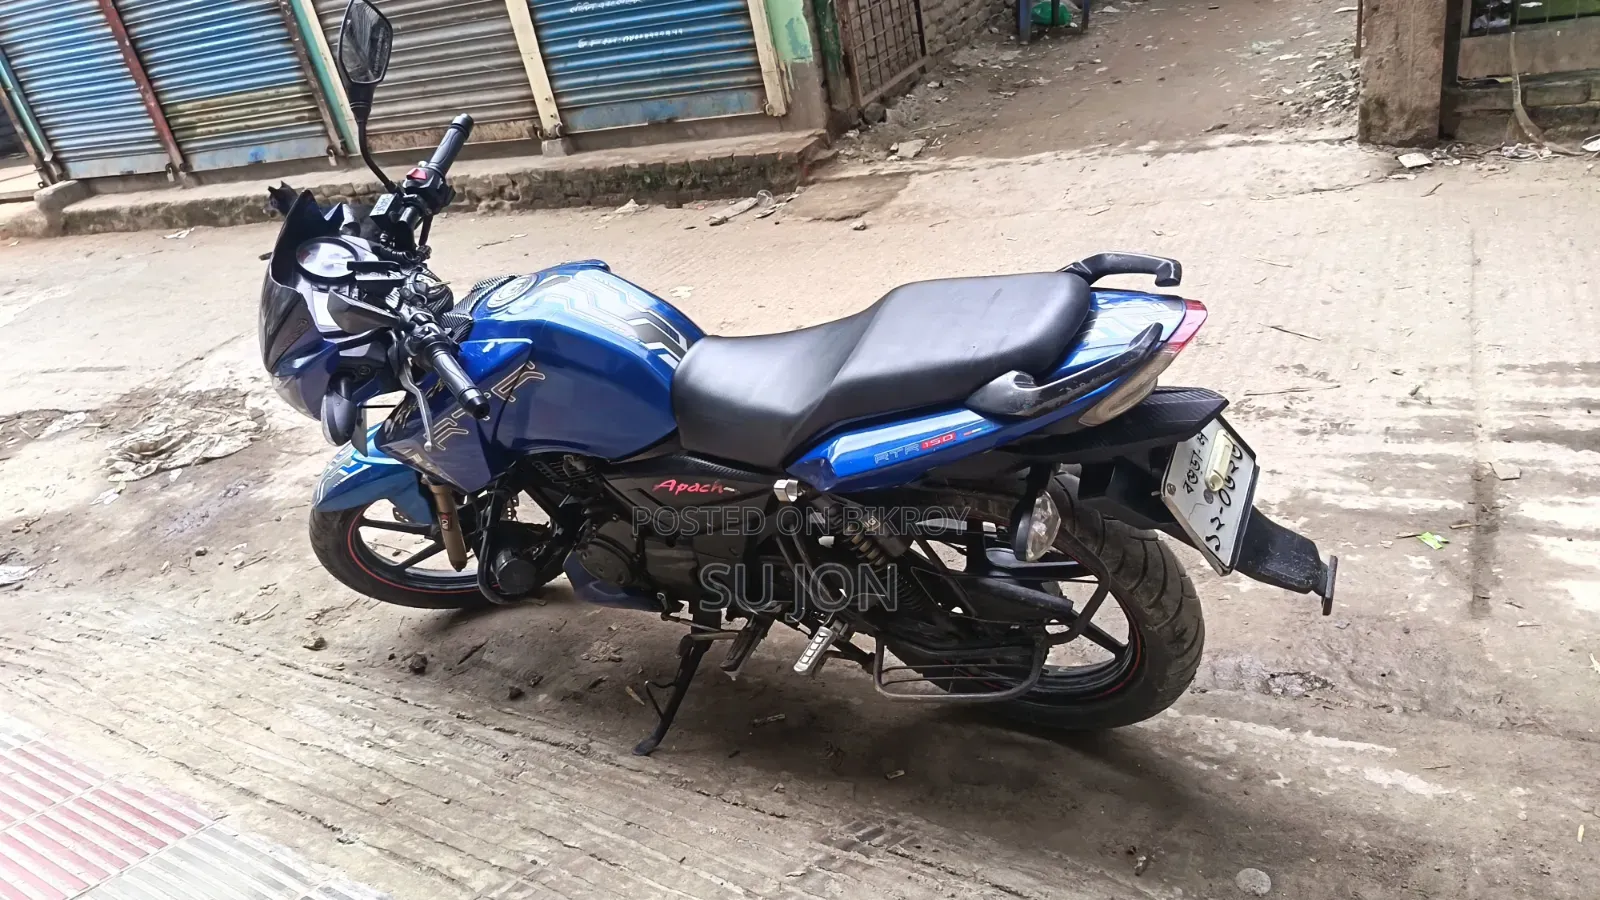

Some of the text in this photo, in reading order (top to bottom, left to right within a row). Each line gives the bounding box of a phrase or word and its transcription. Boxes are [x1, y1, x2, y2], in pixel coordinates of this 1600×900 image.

[874, 433, 955, 464] RTR 150
[652, 479, 739, 496] Apach
